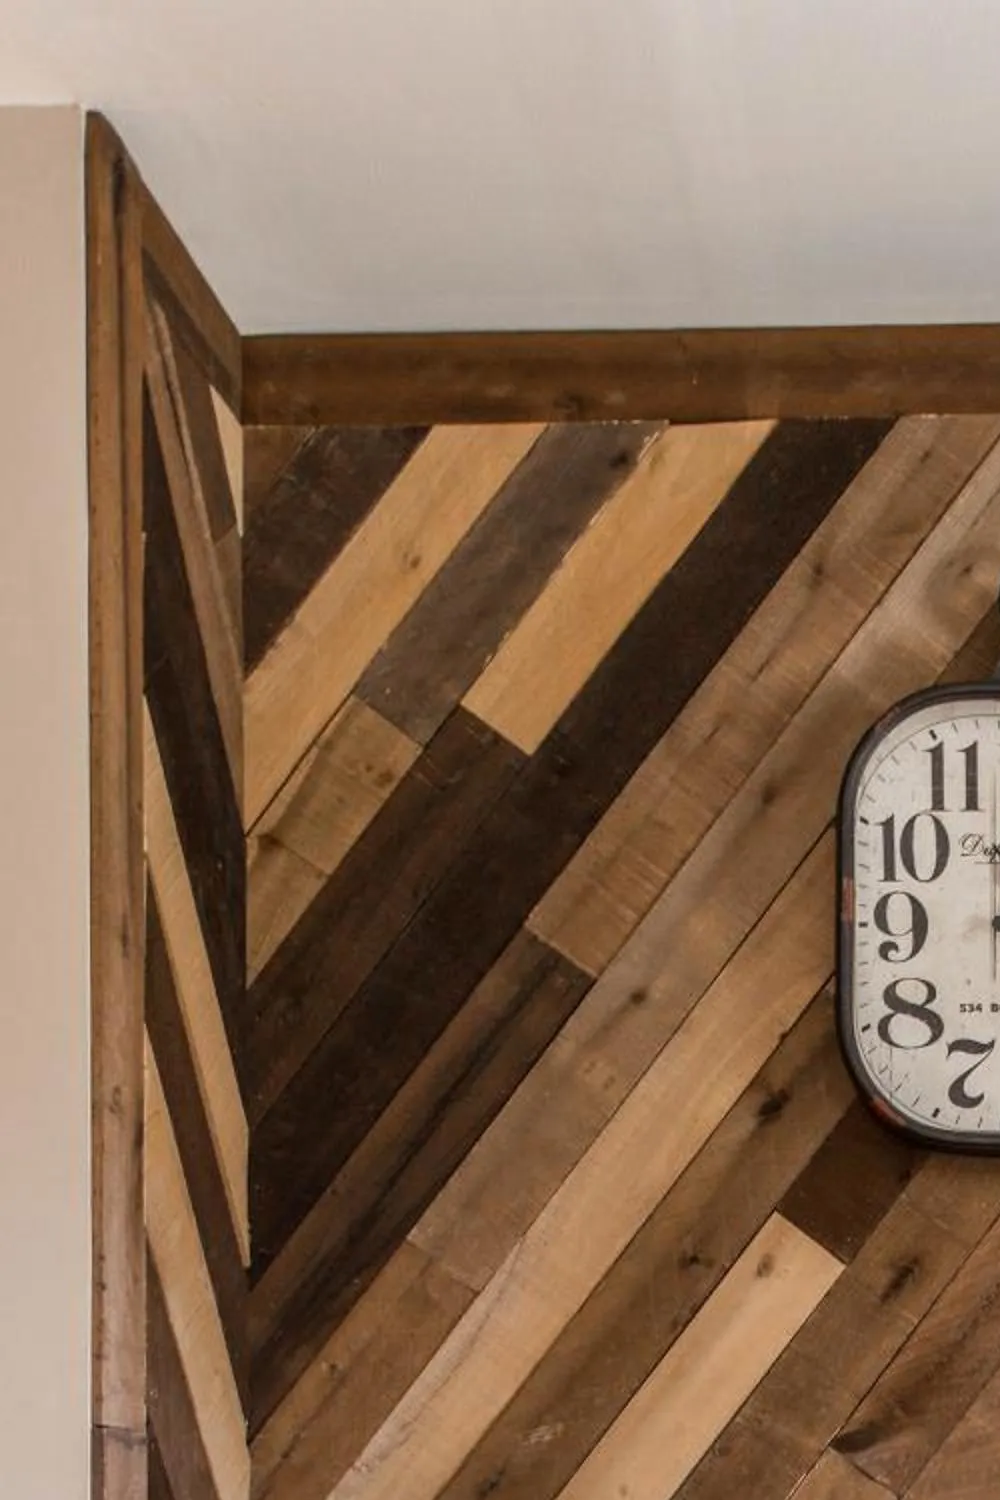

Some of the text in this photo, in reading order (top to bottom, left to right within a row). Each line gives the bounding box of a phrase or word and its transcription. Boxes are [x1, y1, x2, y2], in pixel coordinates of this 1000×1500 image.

[922, 739, 983, 812] 11
[874, 813, 950, 883] 10
[873, 891, 929, 963] 9
[877, 977, 945, 1050] 8
[959, 1003, 983, 1013] 534
[945, 1038, 996, 1109] 7
